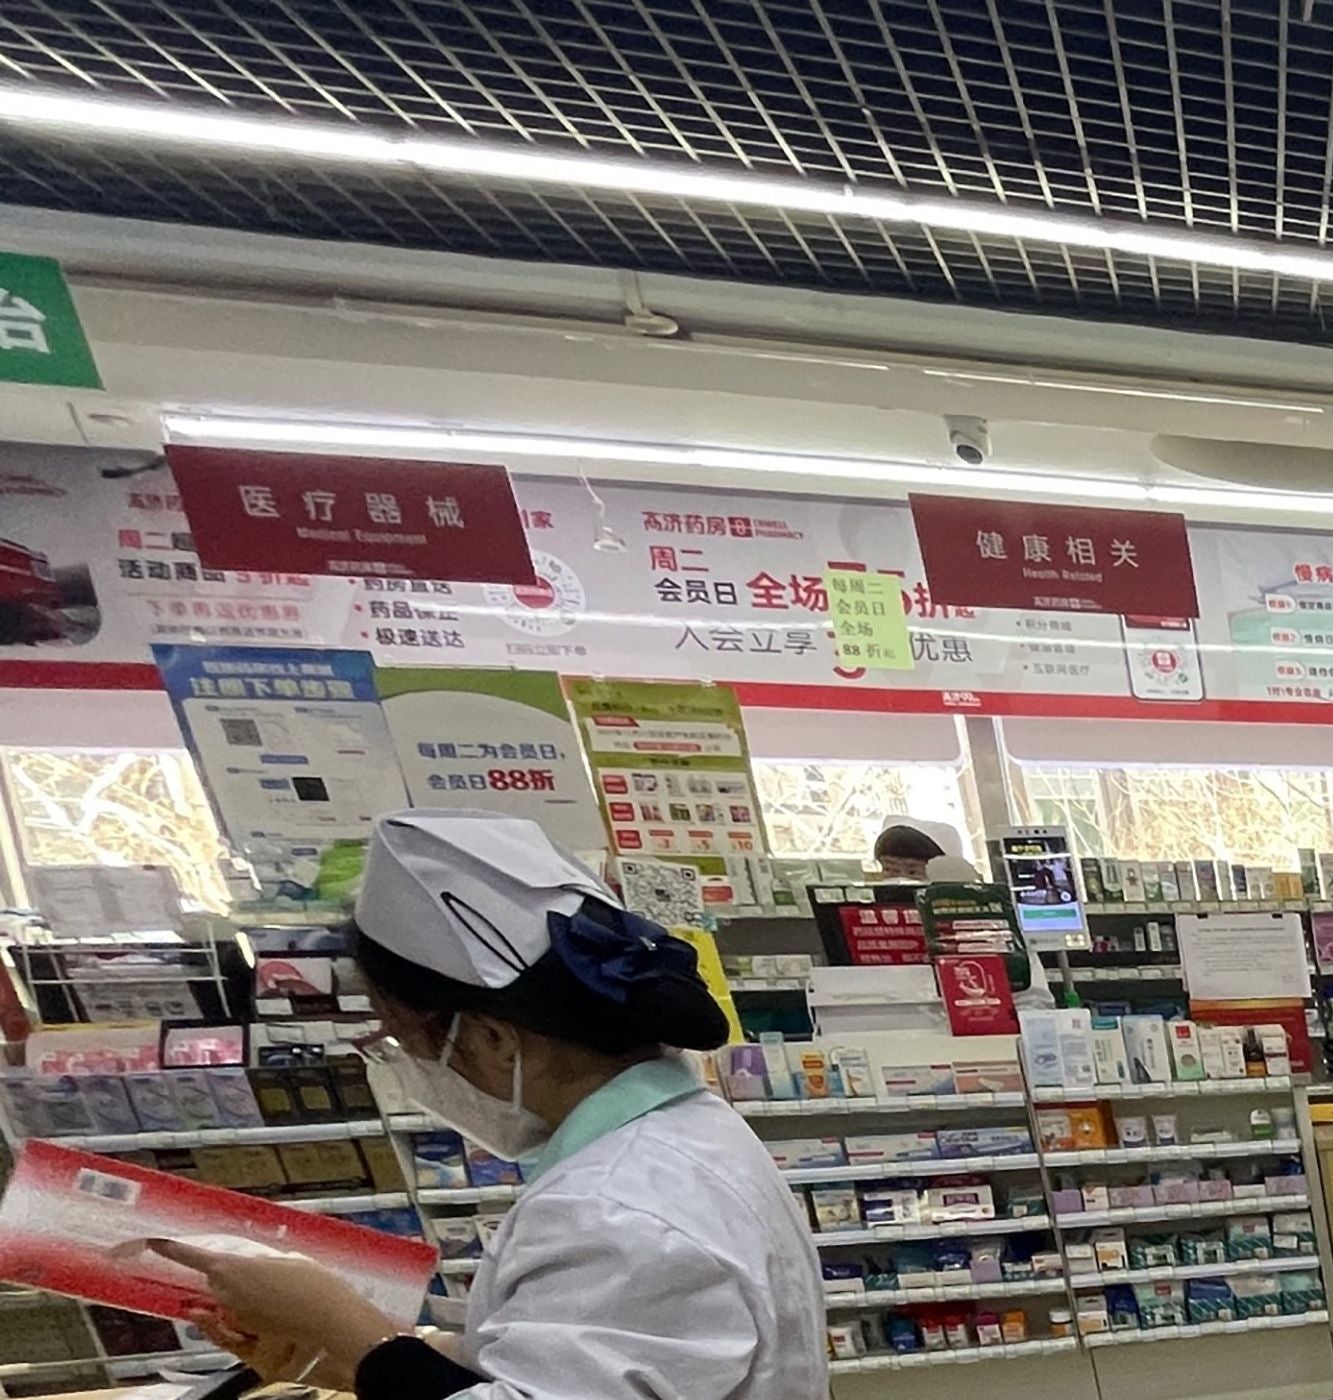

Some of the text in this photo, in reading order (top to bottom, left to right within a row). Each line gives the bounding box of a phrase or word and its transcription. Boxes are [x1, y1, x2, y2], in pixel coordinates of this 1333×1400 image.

[238, 484, 465, 528] 医疗器械
[641, 511, 727, 536] 高济药房
[649, 545, 709, 571] 周二
[975, 530, 1139, 568] 健康相关
[832, 577, 884, 595] 每周二
[1023, 567, 1059, 580] Health
[654, 577, 738, 605] 会员日
[836, 598, 886, 616] 会员日
[376, 627, 465, 648] 极速送达
[840, 620, 874, 637] 全场
[675, 625, 973, 662] 入会立享 优惠
